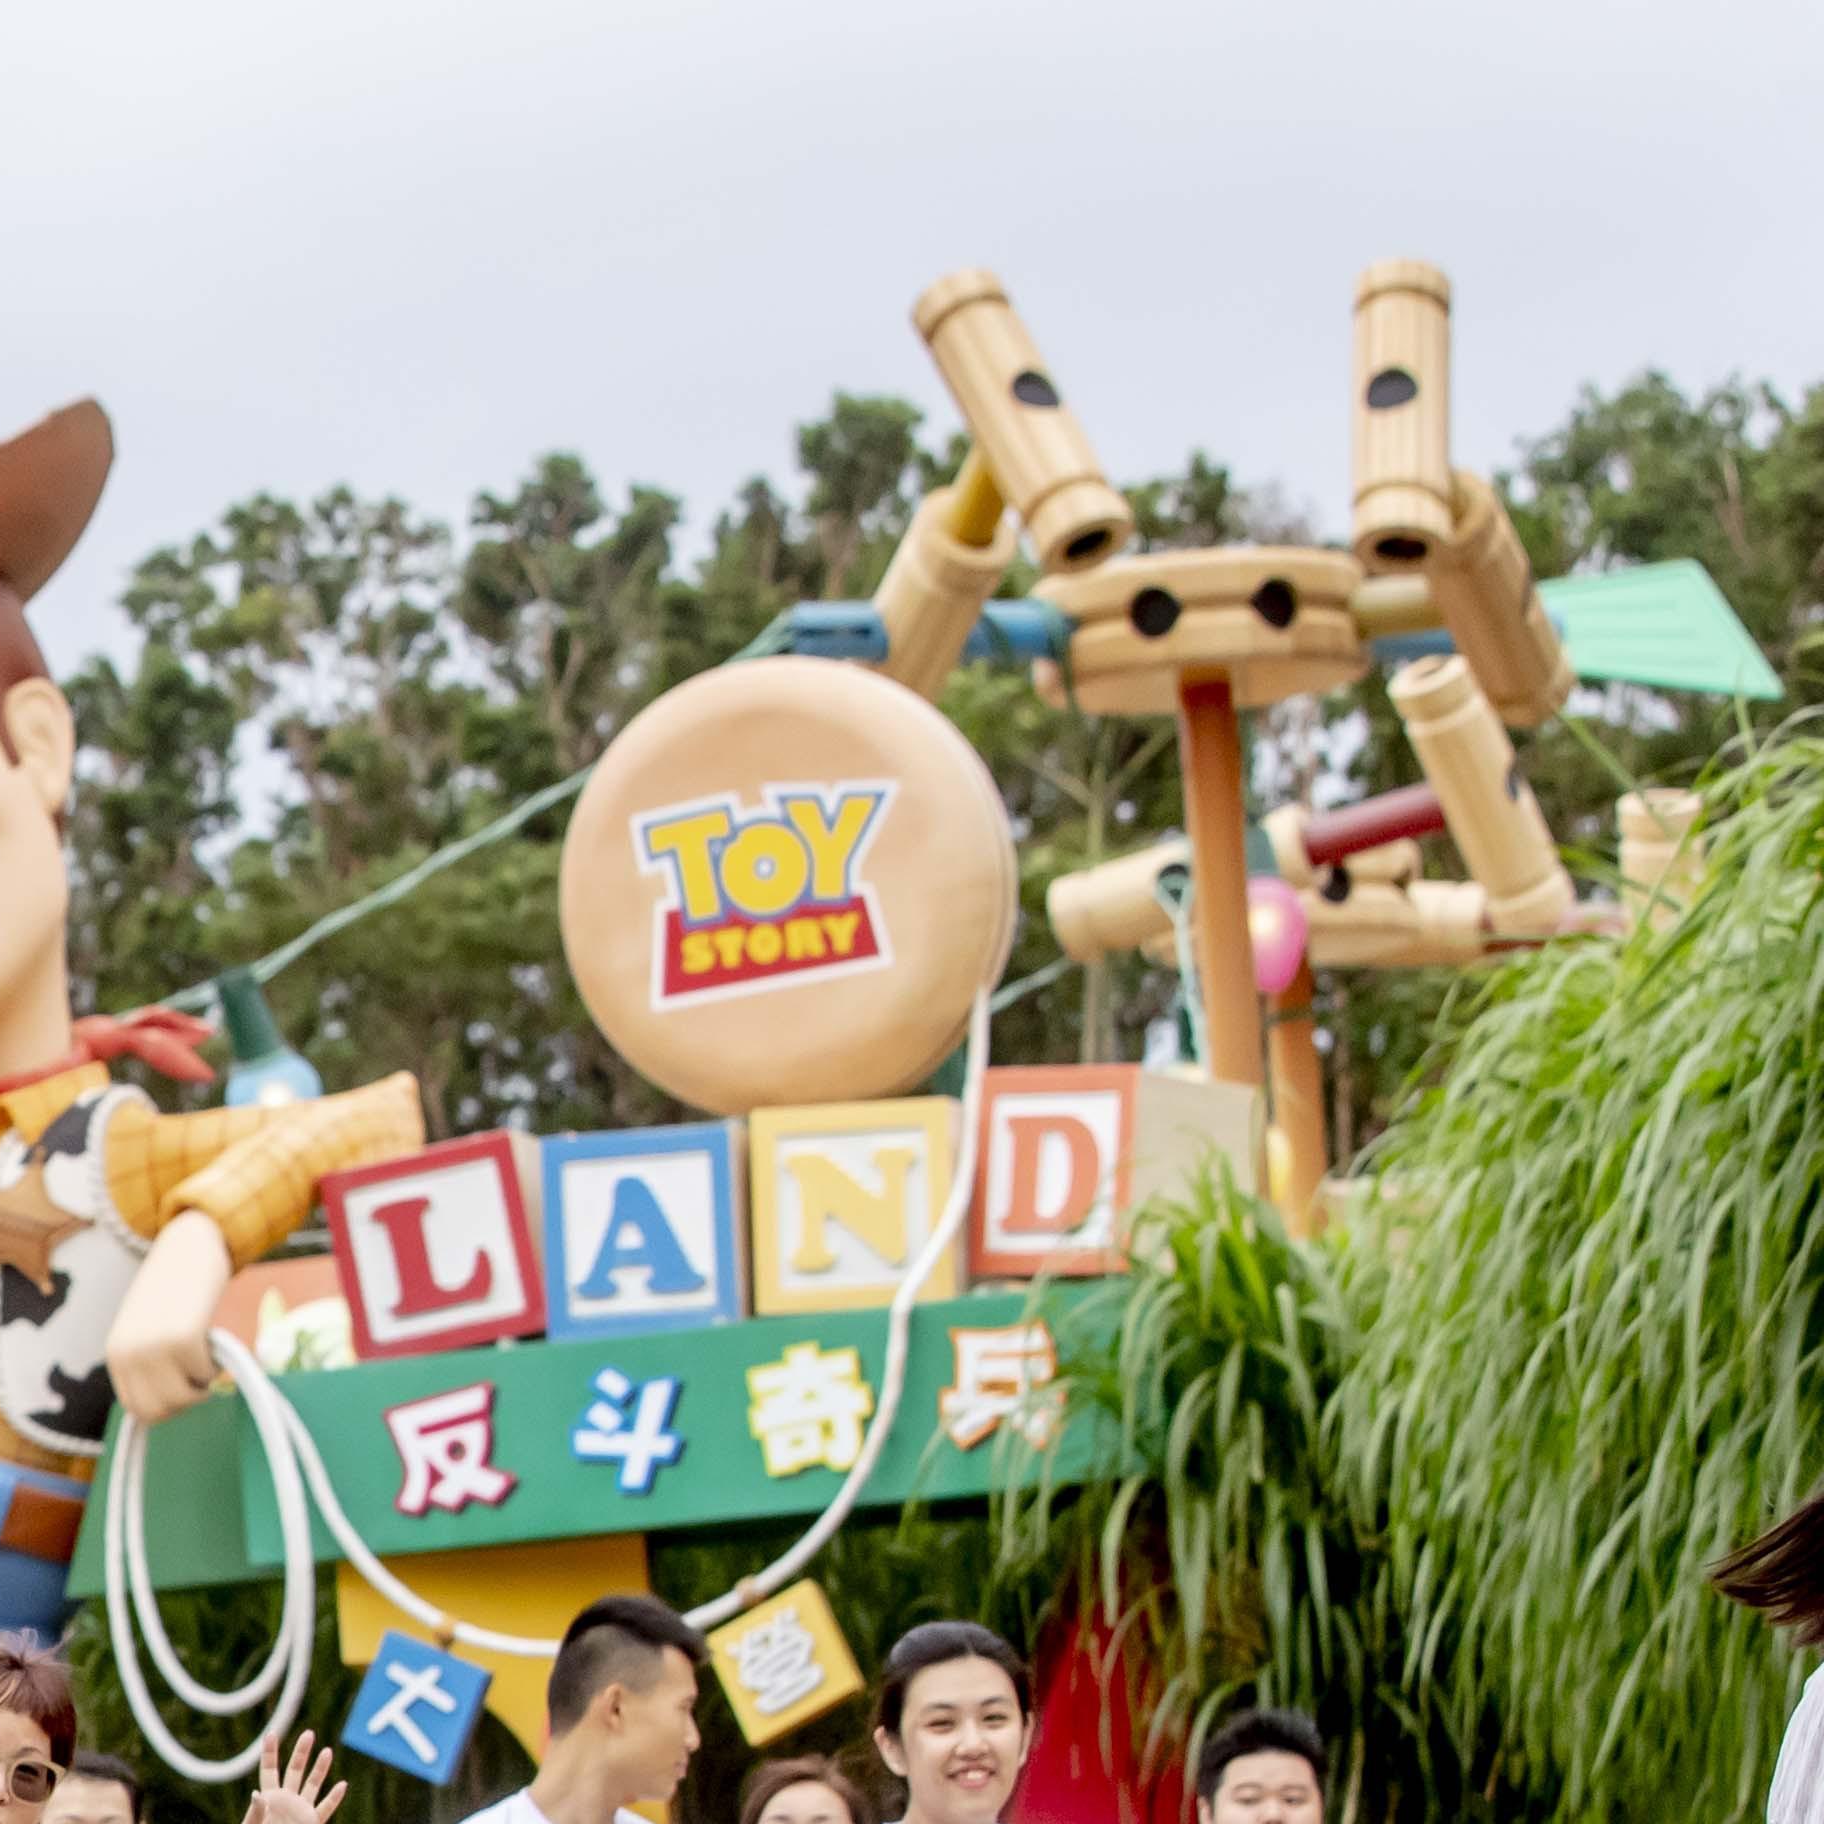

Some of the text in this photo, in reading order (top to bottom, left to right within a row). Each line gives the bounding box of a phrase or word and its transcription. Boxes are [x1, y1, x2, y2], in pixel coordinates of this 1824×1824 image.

[643, 790, 884, 923] TOY
[680, 909, 864, 974] STORY
[370, 1113, 1103, 1319] LAND
[385, 1320, 1064, 1517] 反斗奇兵
[364, 1656, 458, 1766] 大
